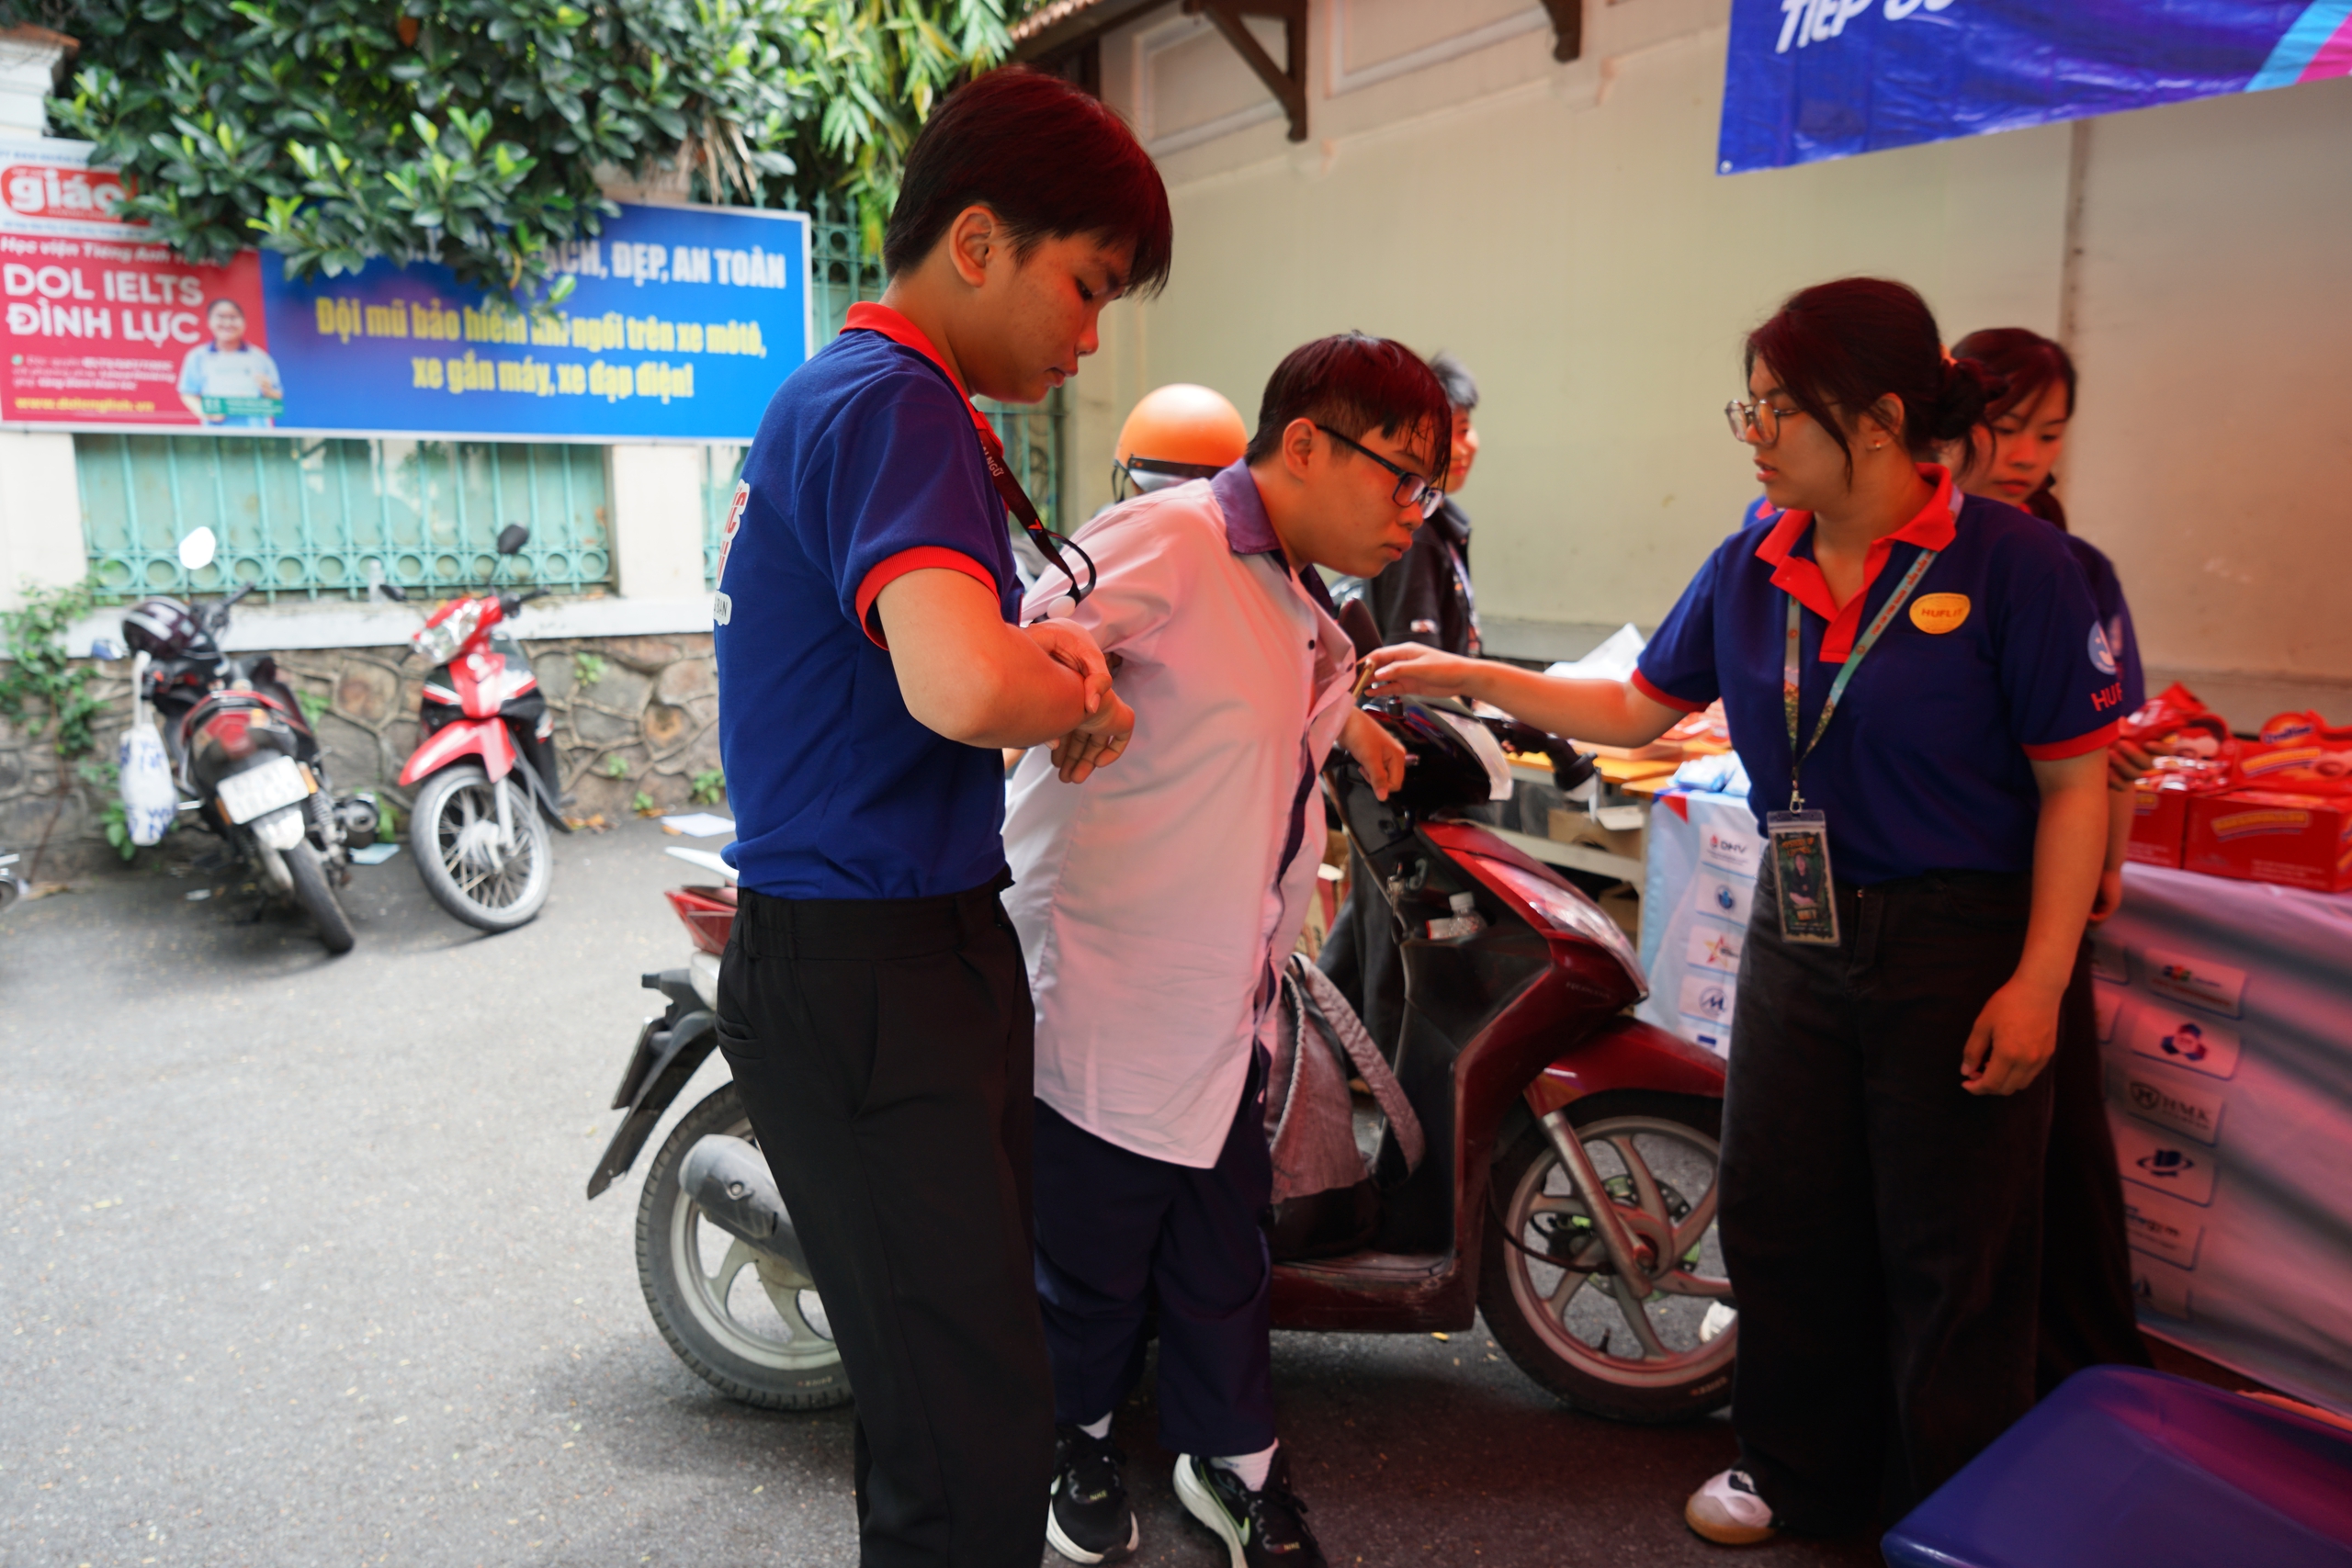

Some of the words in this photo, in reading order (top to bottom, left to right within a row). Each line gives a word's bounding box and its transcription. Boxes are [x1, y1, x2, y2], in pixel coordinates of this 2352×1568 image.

[3, 263, 96, 300] DOL
[103, 269, 205, 308] IELTS
[610, 241, 670, 288] ĐẸP,
[672, 245, 711, 284] AN
[713, 245, 786, 289] TOÀN
[6, 296, 112, 340] ĐÌNH
[121, 309, 201, 349] LỰC
[315, 297, 362, 344] Đội
[365, 298, 408, 338] mũ
[412, 298, 461, 342] bảo
[571, 310, 625, 353] ngồi
[627, 315, 675, 352] trên
[676, 322, 705, 354] xe
[412, 357, 444, 389] xe
[498, 355, 556, 397] máy,
[556, 363, 587, 395] xe
[588, 359, 634, 403] đạp
[636, 360, 695, 405] điện!
[1921, 607, 1964, 619] HUFLIT
